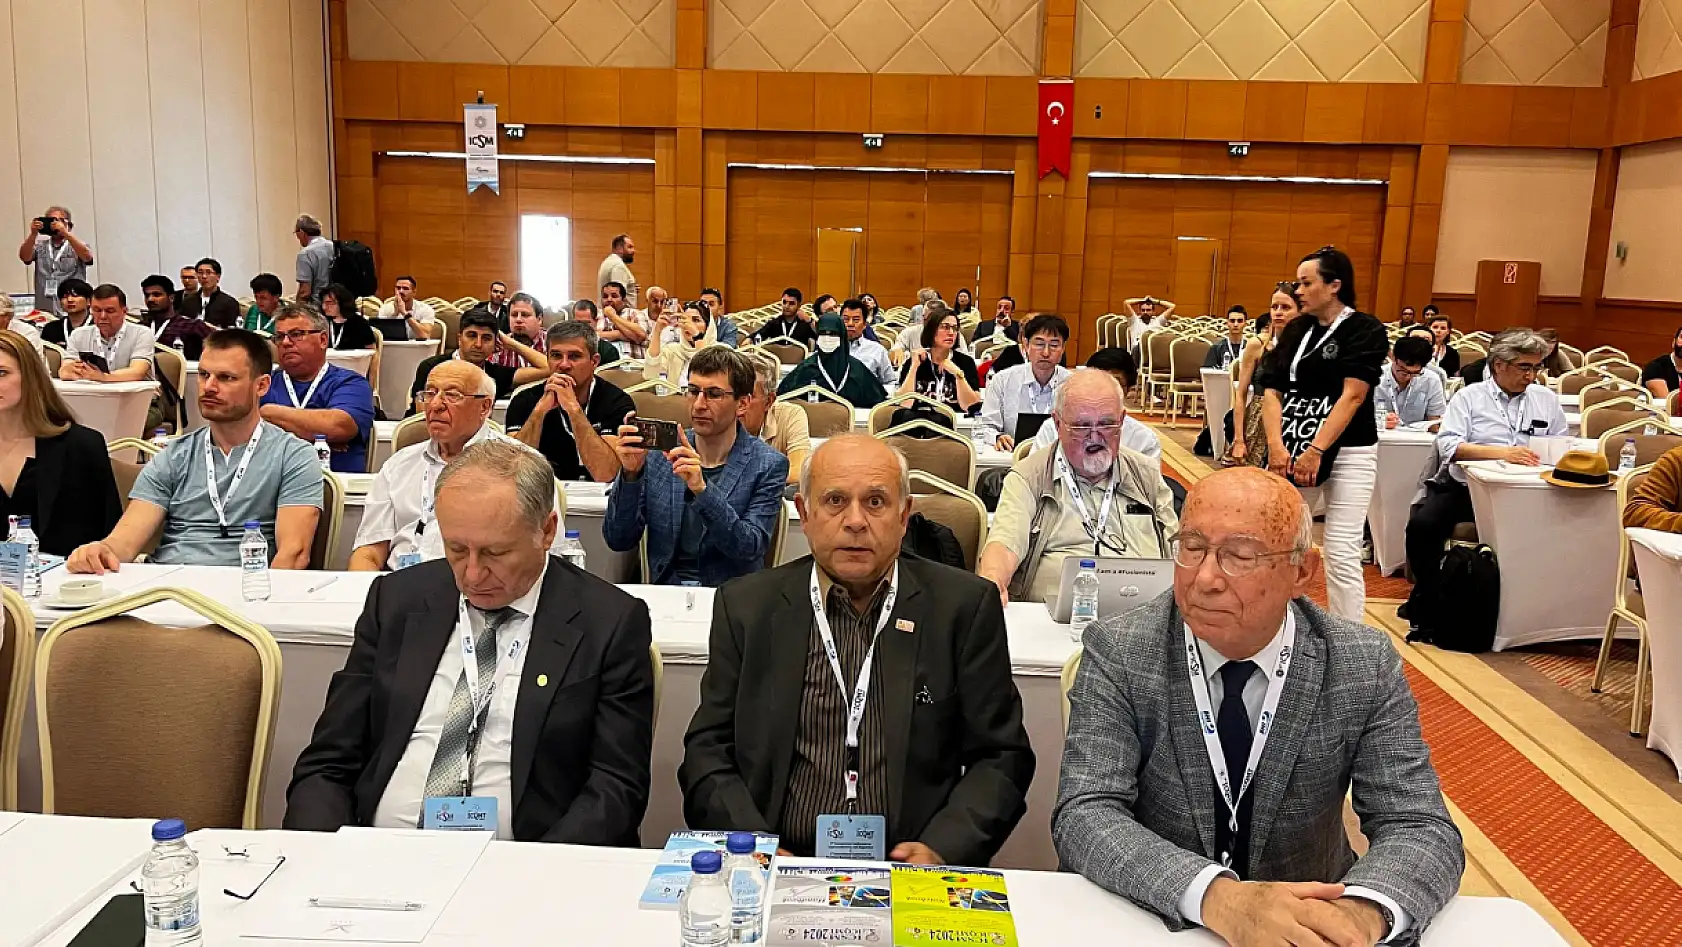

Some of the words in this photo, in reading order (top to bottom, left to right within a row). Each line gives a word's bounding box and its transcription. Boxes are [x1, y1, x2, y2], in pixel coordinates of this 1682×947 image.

[469, 135, 494, 148] ICSM
[803, 928, 829, 940] 2024
[930, 929, 954, 941] 2024
